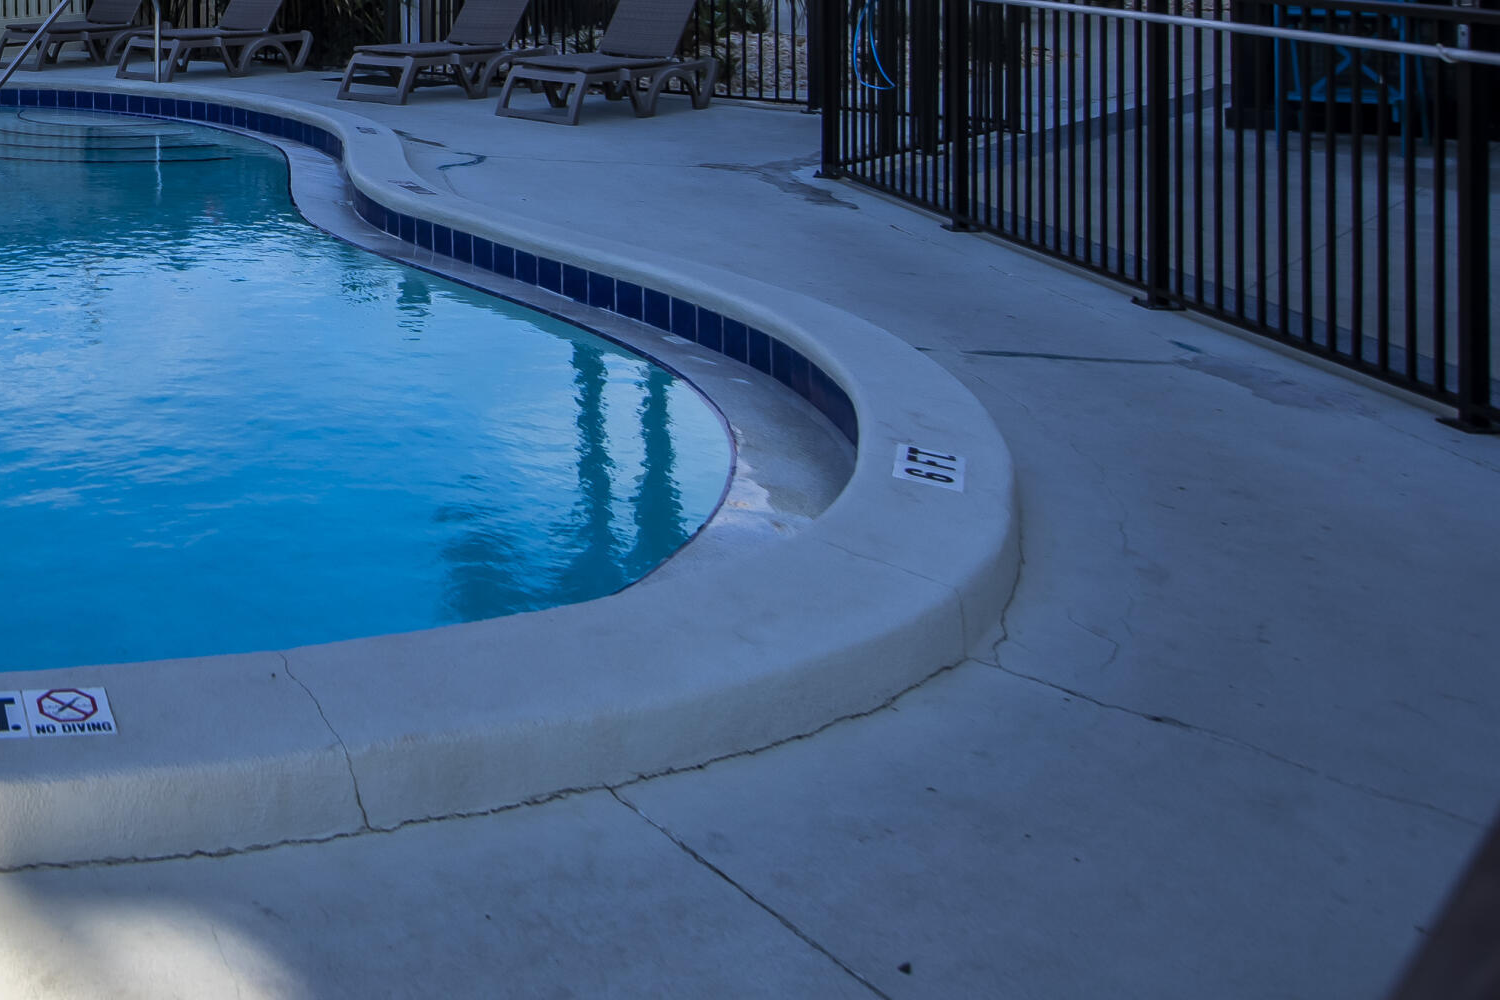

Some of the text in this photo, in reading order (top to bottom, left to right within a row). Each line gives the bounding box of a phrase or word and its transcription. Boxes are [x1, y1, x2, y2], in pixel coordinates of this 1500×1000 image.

[904, 467, 955, 483] 6
[35, 720, 113, 735] NO DIVING
